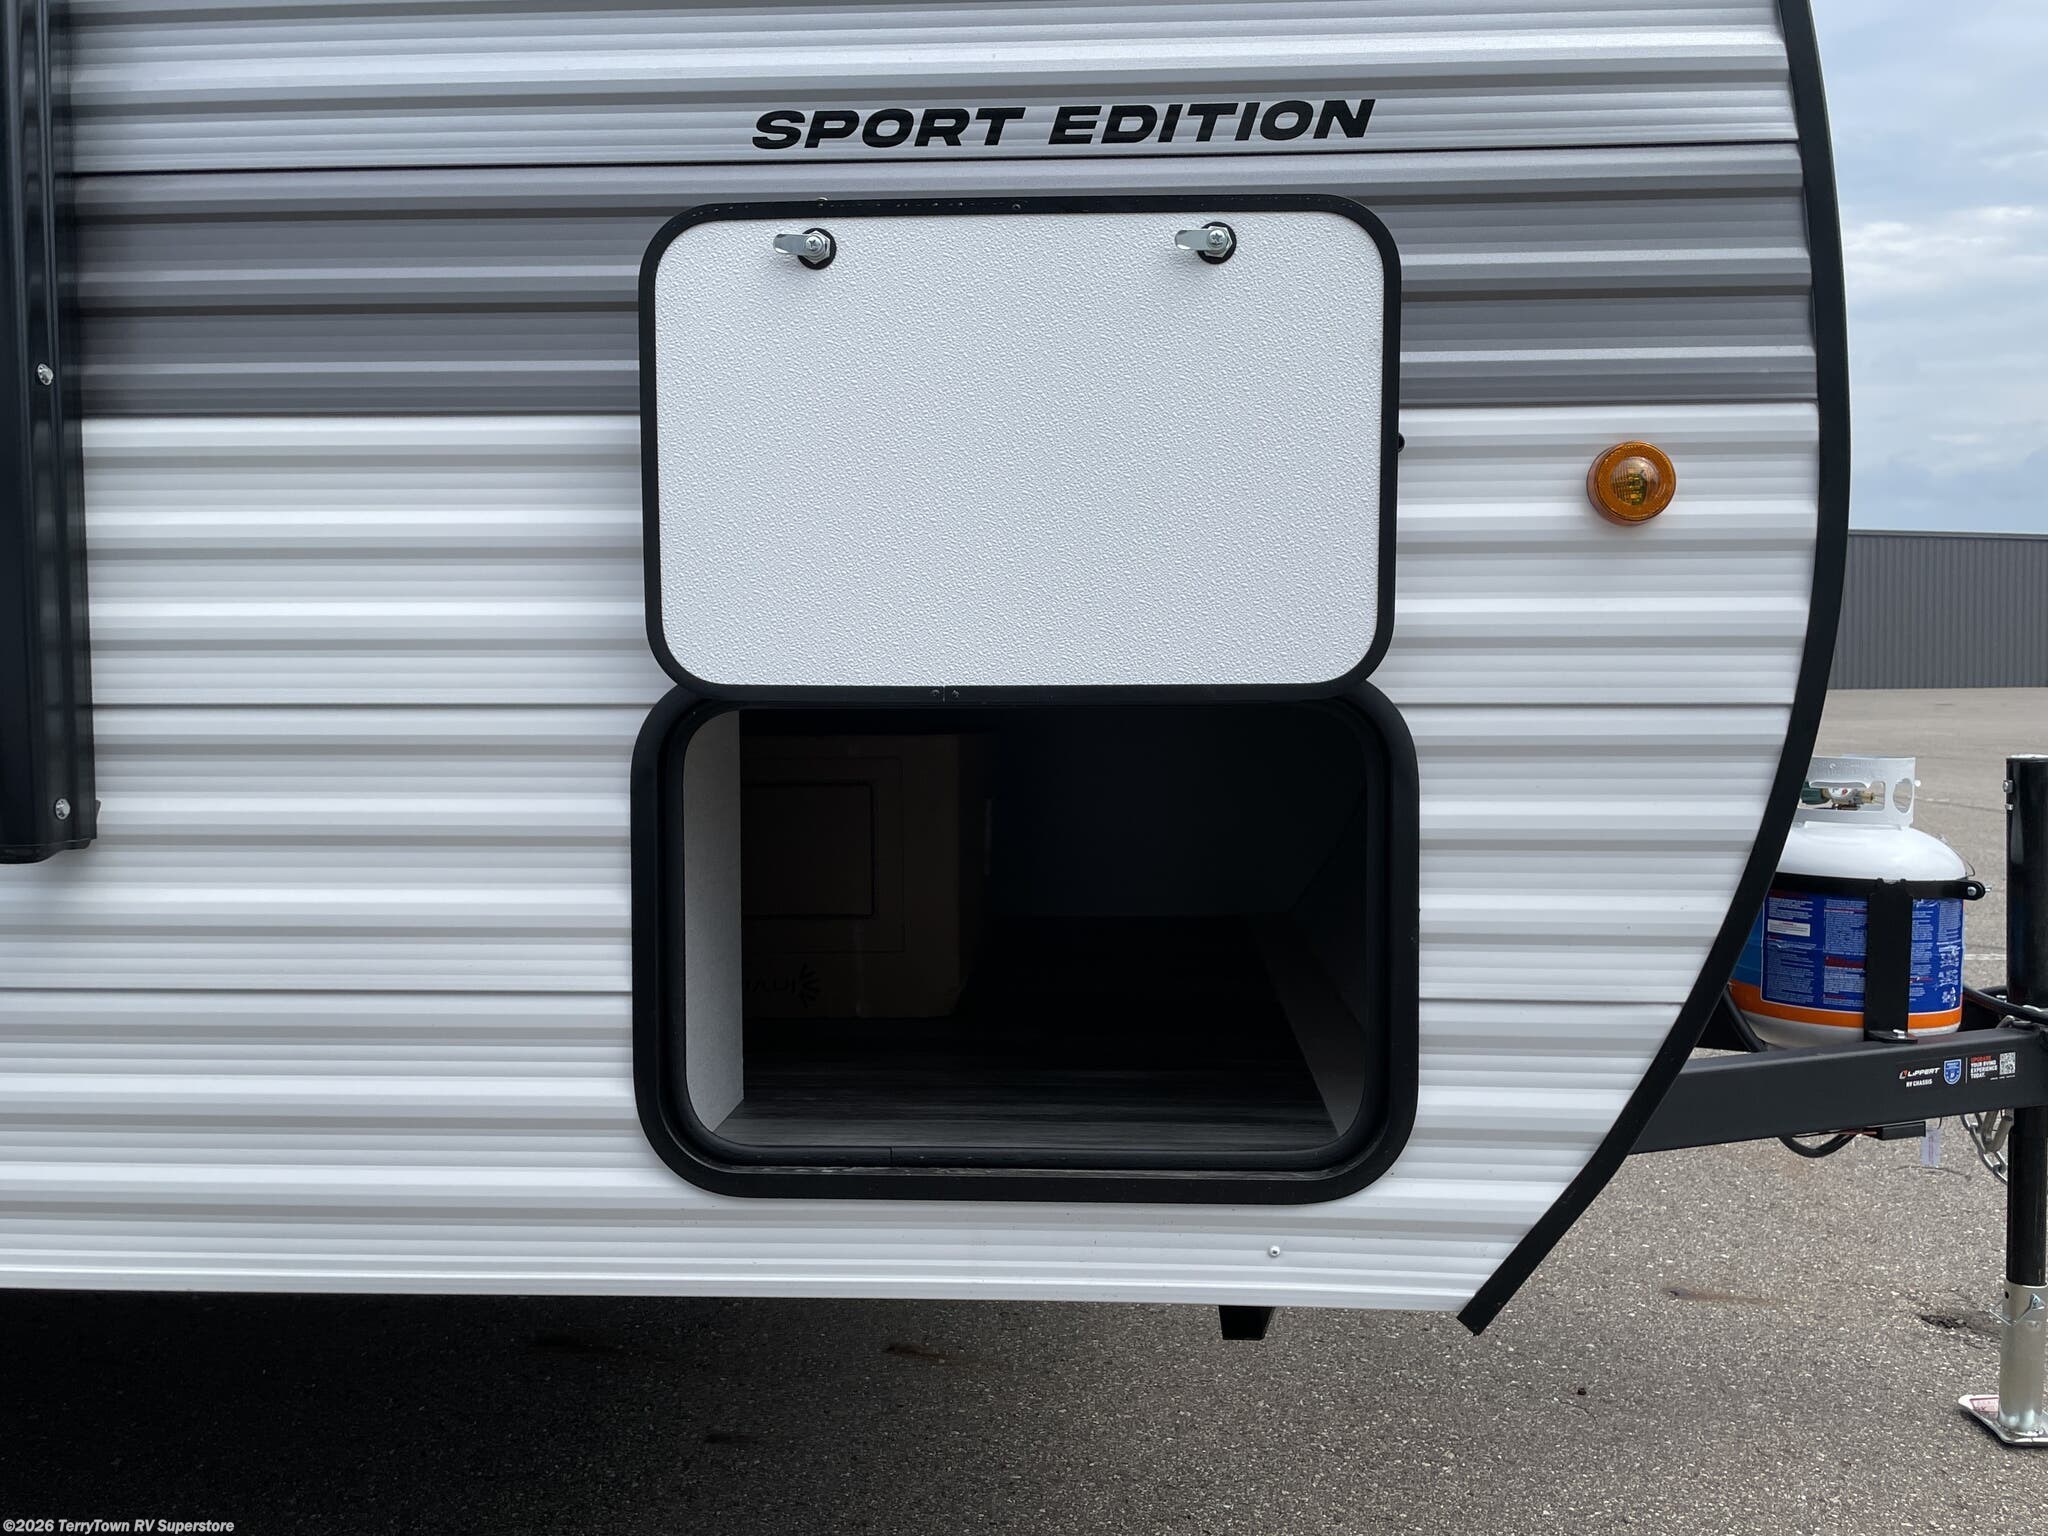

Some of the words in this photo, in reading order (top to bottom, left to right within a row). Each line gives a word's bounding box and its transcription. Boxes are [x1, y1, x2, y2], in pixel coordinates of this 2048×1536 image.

[752, 107, 1025, 148] SPORT
[1048, 99, 1377, 144] EDITION
[1913, 1079, 1933, 1087] CHASSIS
